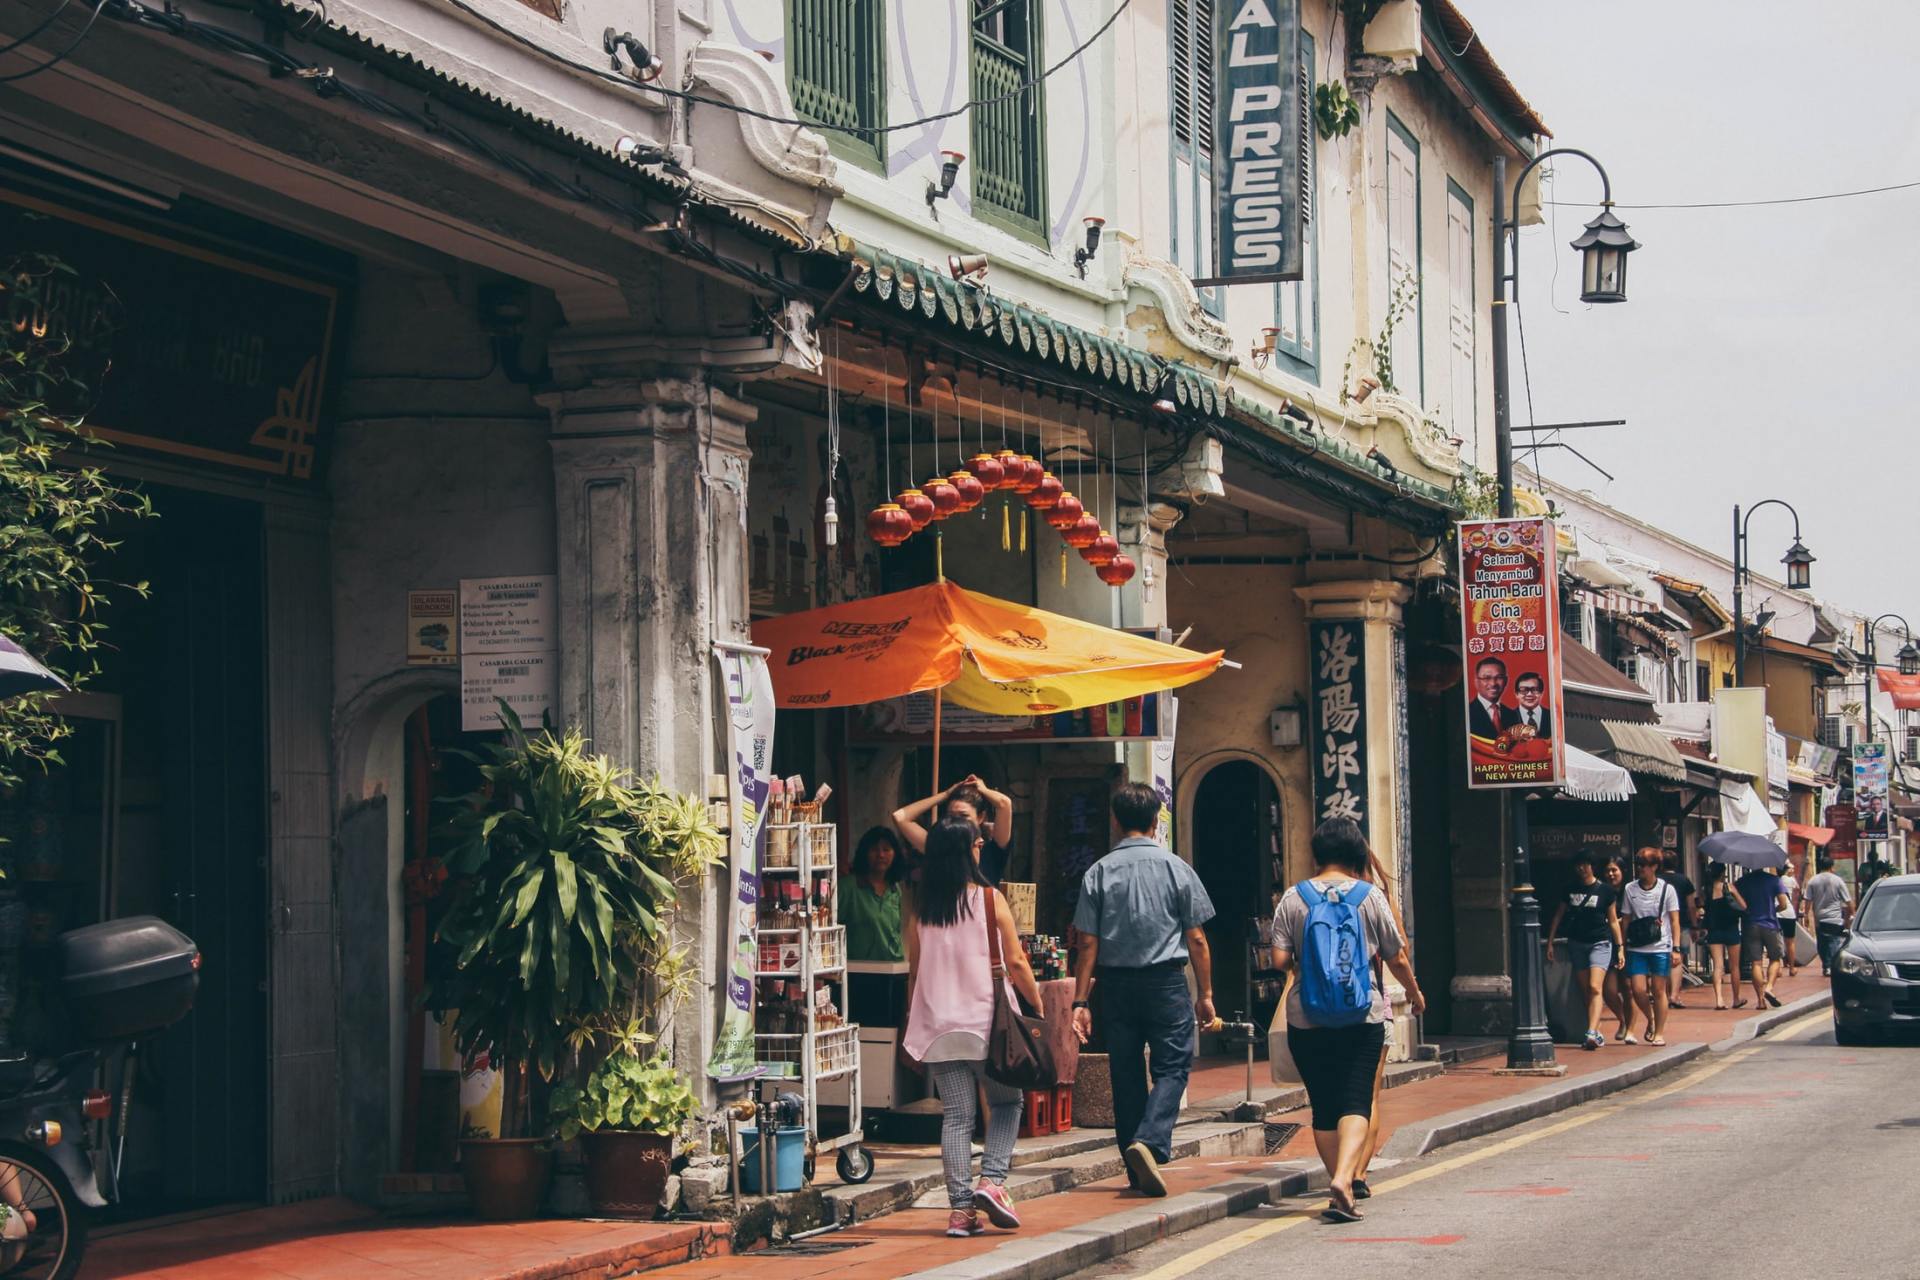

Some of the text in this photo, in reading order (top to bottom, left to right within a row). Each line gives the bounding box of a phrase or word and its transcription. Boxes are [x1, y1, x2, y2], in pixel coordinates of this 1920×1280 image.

[1229, 85, 1284, 268] PRESS
[1484, 553, 1524, 566] Selamat
[1475, 568, 1533, 582] Menyambut
[1468, 583, 1542, 599] Tahun Baru
[1491, 603, 1521, 618] Cina
[1469, 635, 1545, 653] 恭賀新禧
[787, 644, 845, 666] Black
[1474, 762, 1549, 773] HAPPY CHINESE
[1485, 771, 1536, 781] NEW YEAR
[1583, 832, 1622, 843] JUMBO
[1337, 937, 1356, 1008] adidas
